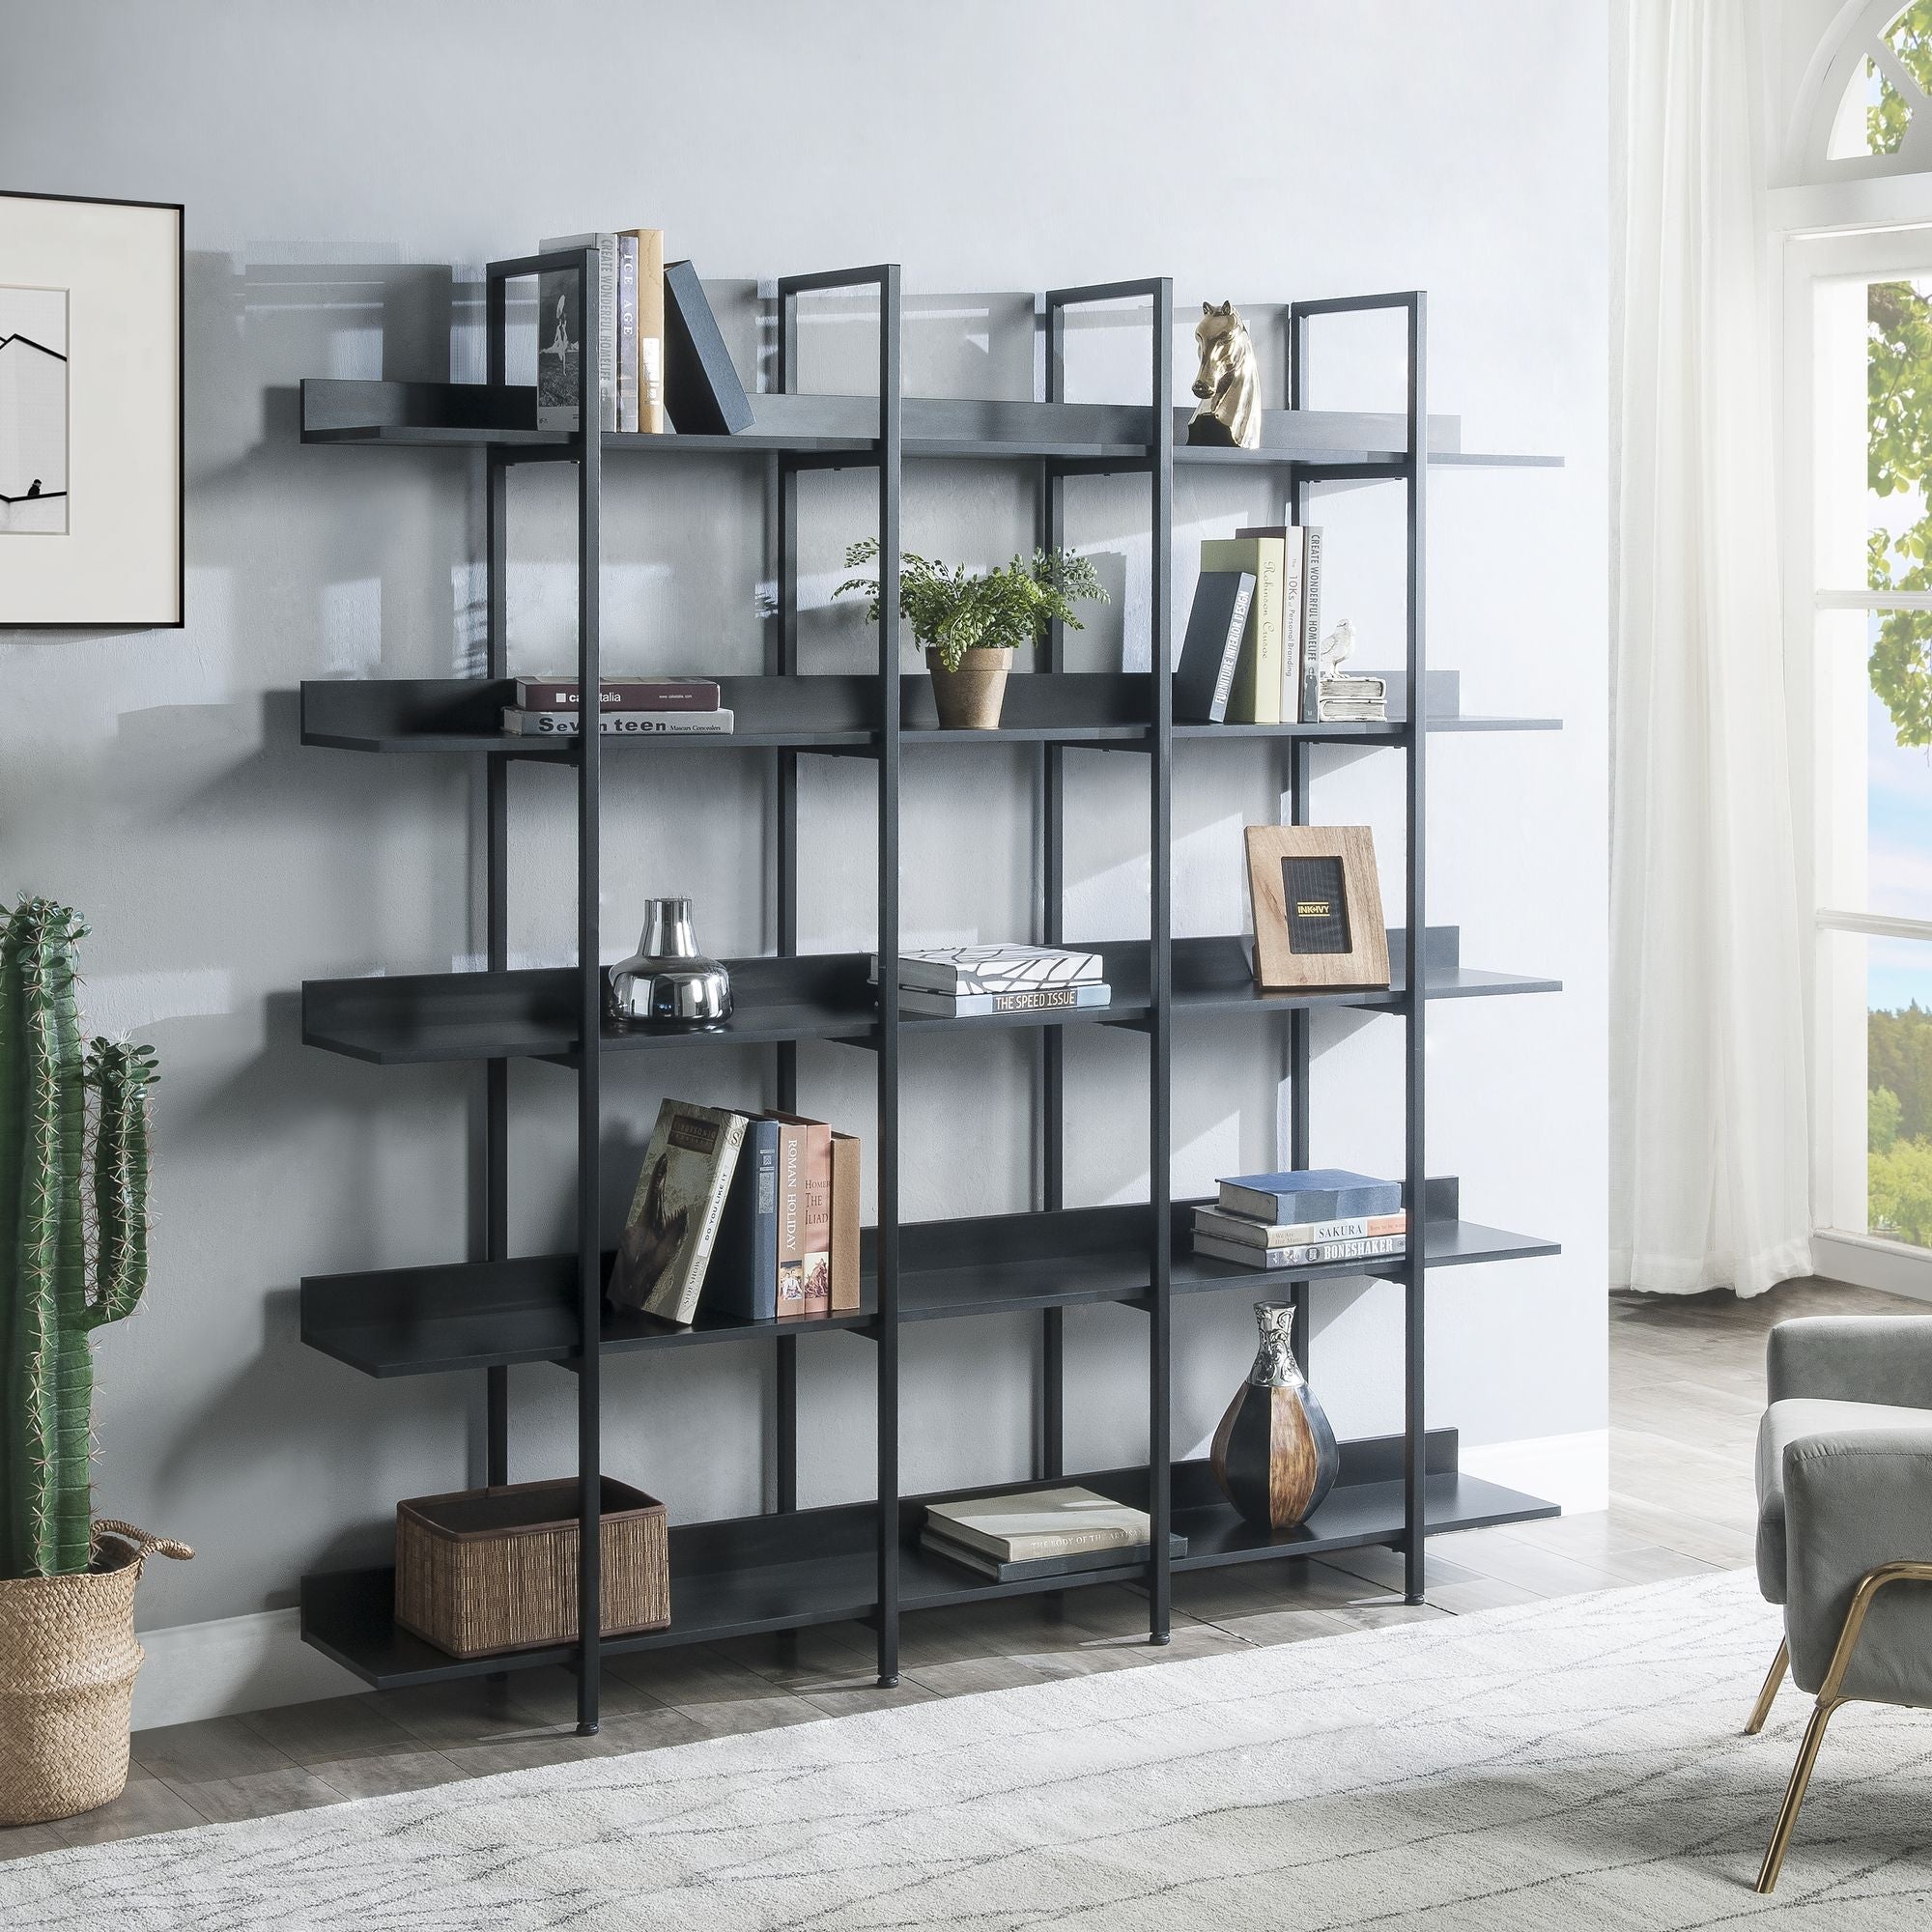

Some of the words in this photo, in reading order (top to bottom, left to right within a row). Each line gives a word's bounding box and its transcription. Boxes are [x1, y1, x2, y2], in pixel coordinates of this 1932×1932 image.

[601, 240, 613, 272] CREATE
[624, 254, 633, 284] ICE
[600, 275, 612, 332] WONDERFUL
[624, 300, 633, 335] AGE
[600, 335, 611, 381] HOMELIFE
[1310, 534, 1320, 564] CREATE
[1233, 590, 1250, 620] DESIGN
[1263, 561, 1275, 615] Robinson
[1288, 576, 1298, 600] 10Ks
[1309, 567, 1319, 618] WONDERFUL
[1225, 621, 1242, 659] INTERIOR
[1307, 620, 1317, 661] HOMELIFE
[1285, 643, 1294, 677] Branding
[1215, 657, 1234, 704] FURNITURE
[538, 717, 607, 732] Sevn
[614, 718, 666, 732] teen
[995, 996, 1014, 1010] THE
[1016, 994, 1045, 1008] SPEED
[1047, 991, 1076, 1005] ISSUE
[787, 1139, 797, 1188] ROMAN
[705, 1228, 711, 1241] DO
[715, 1184, 724, 1205] LIKE
[722, 1173, 727, 1182] IT
[805, 1210, 828, 1225] ILIAD
[806, 1193, 823, 1208] THE
[787, 1194, 796, 1251] HOLIDAY
[1319, 1226, 1363, 1238] SAKURA
[1324, 1238, 1393, 1260] BONESHAKER
[683, 1261, 700, 1305] SIDESHOW
[1076, 1535, 1087, 1544] OF
